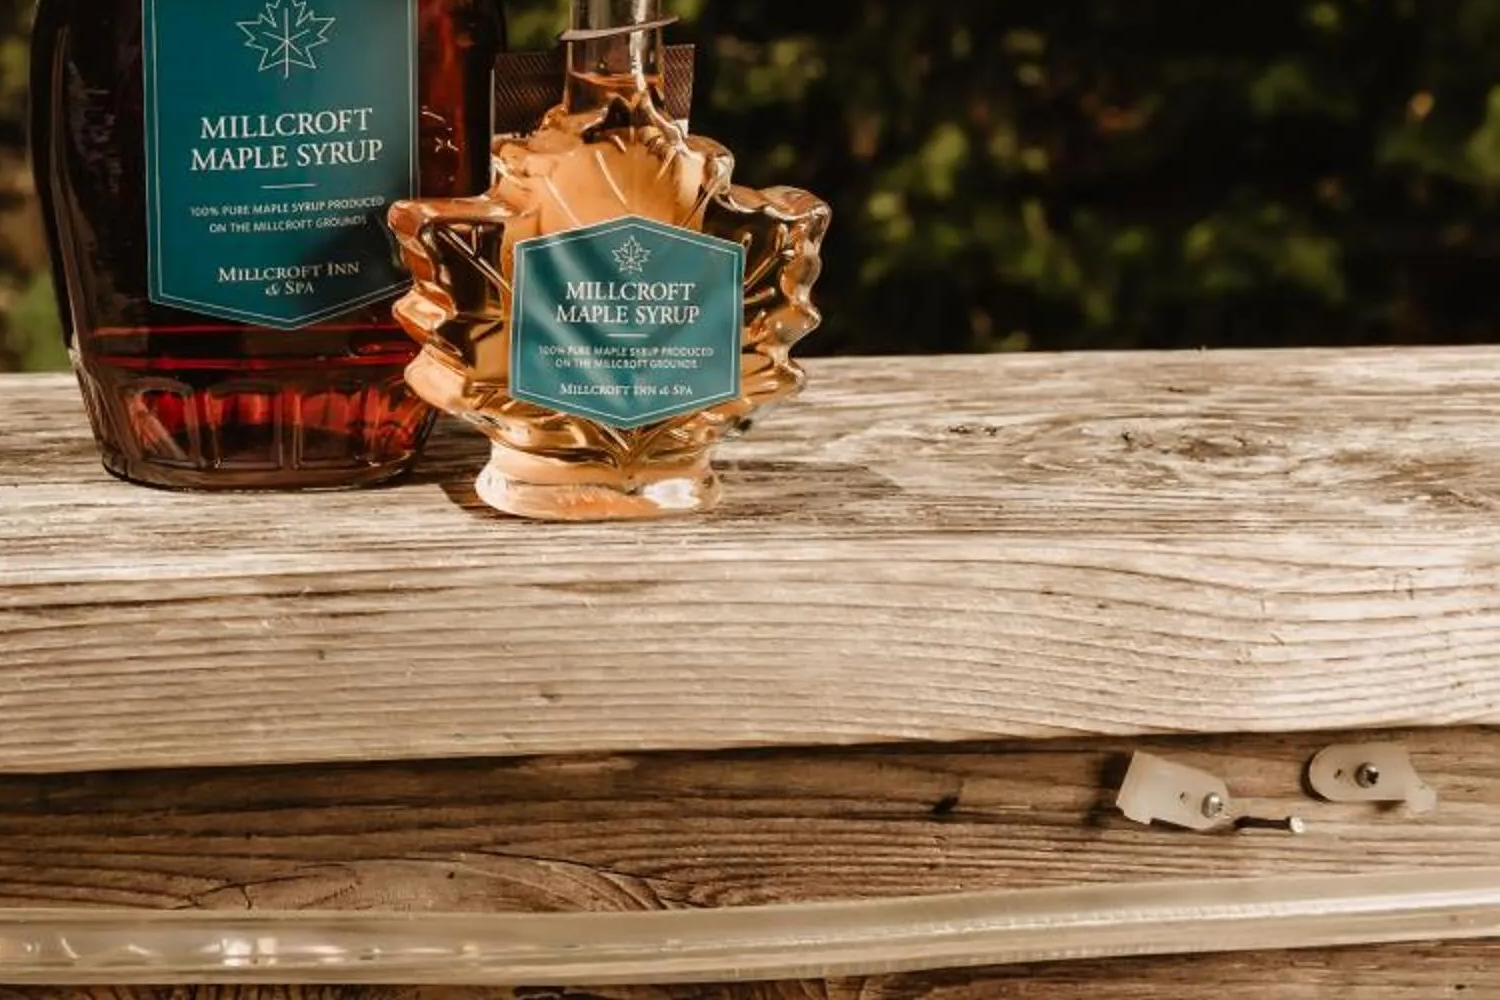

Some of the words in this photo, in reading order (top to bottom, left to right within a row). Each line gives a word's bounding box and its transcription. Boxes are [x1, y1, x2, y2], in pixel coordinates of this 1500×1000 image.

[199, 107, 373, 140] MILLCROFT
[189, 145, 288, 172] MAPLE
[296, 140, 383, 167] SYRUP
[190, 206, 219, 217] 100%
[222, 205, 250, 216] PURE
[252, 203, 289, 215] MAPLE
[291, 201, 325, 213] SYRUP
[328, 196, 385, 211] PRODUCED
[209, 222, 227, 233] ON
[230, 221, 251, 232] THE
[253, 218, 313, 232] MILLCROFT
[327, 262, 360, 276] INN
[565, 281, 696, 301] MILLCROFT
[556, 304, 629, 324] MAPLE
[636, 305, 700, 324] SYRUP
